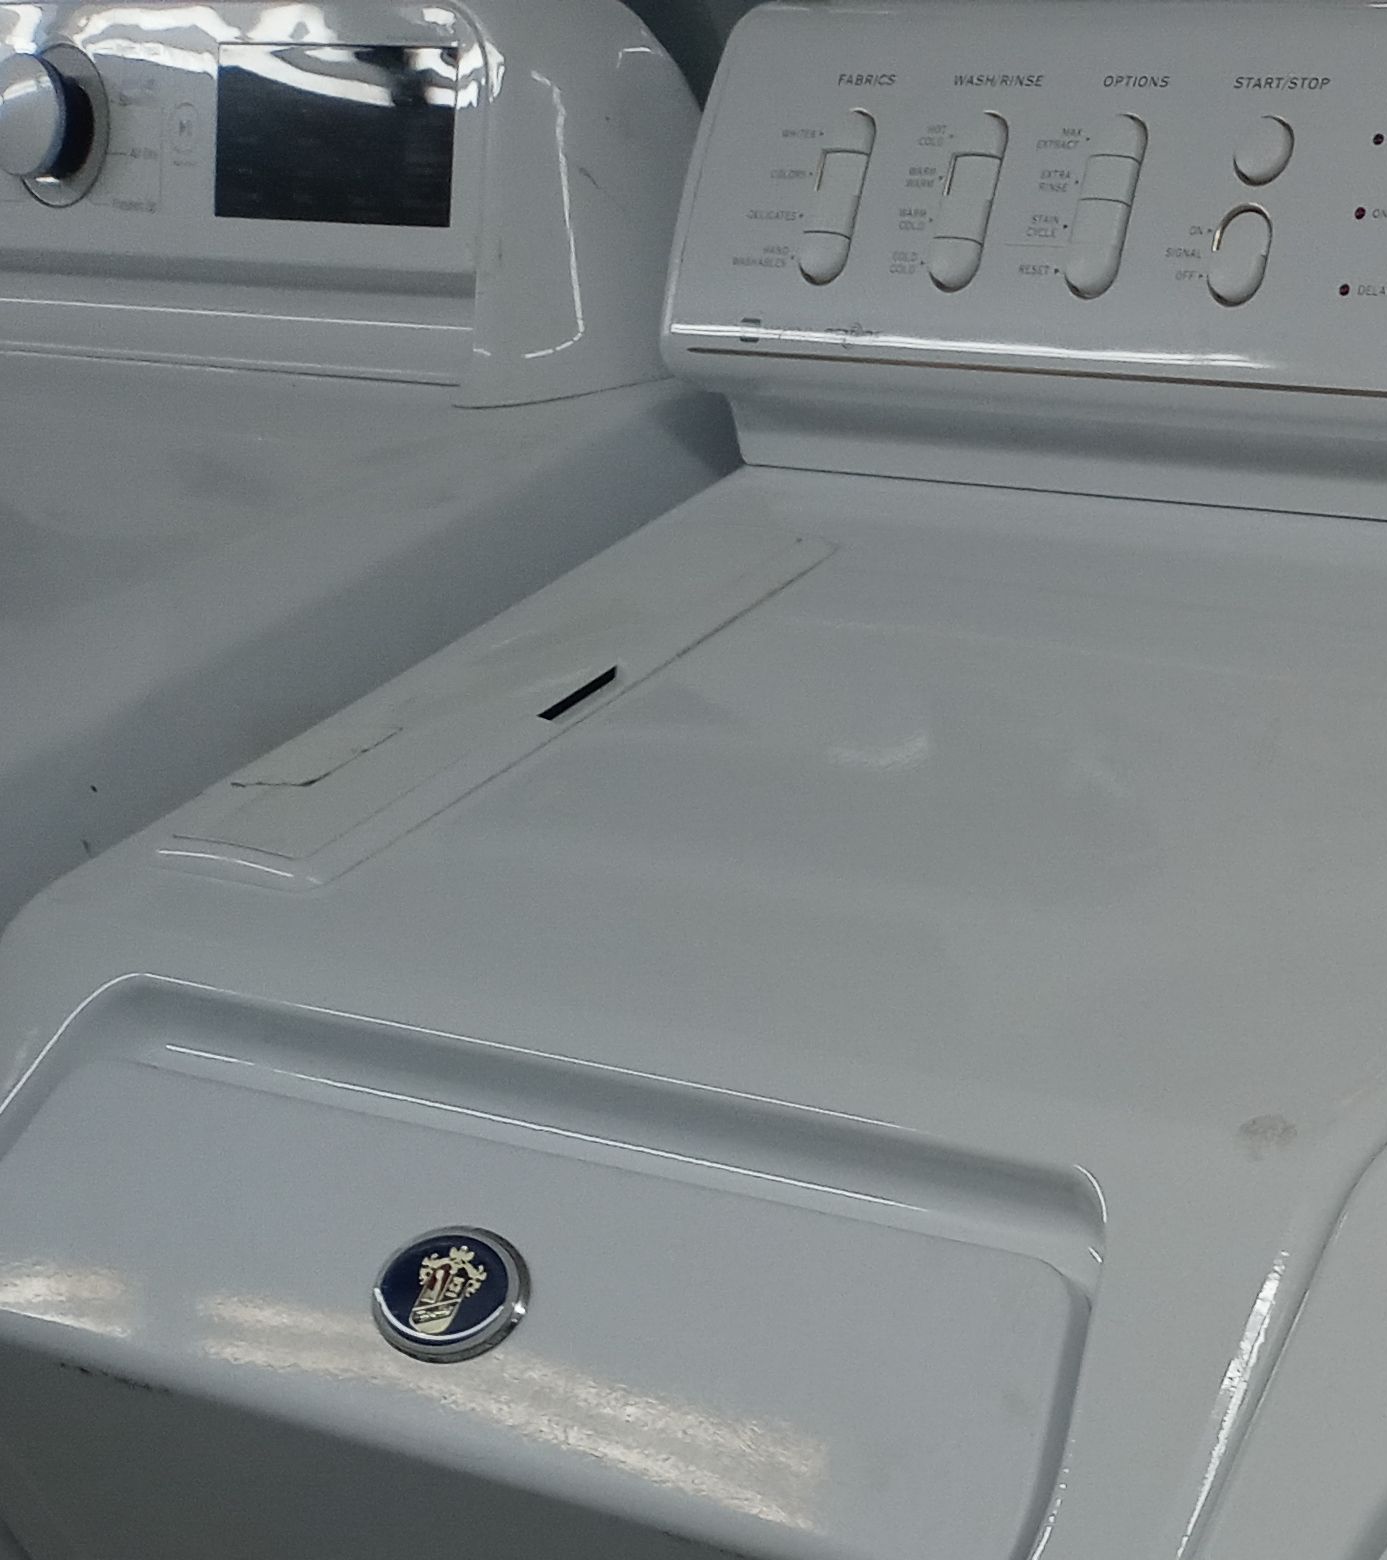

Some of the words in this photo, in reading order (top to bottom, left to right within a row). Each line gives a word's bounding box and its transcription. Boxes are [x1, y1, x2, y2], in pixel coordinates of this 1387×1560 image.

[837, 73, 897, 87] FABRICS
[953, 74, 1046, 88] WASH/RINSE
[1103, 75, 1171, 89] OPTIONS
[1232, 76, 1332, 91] START/STOP
